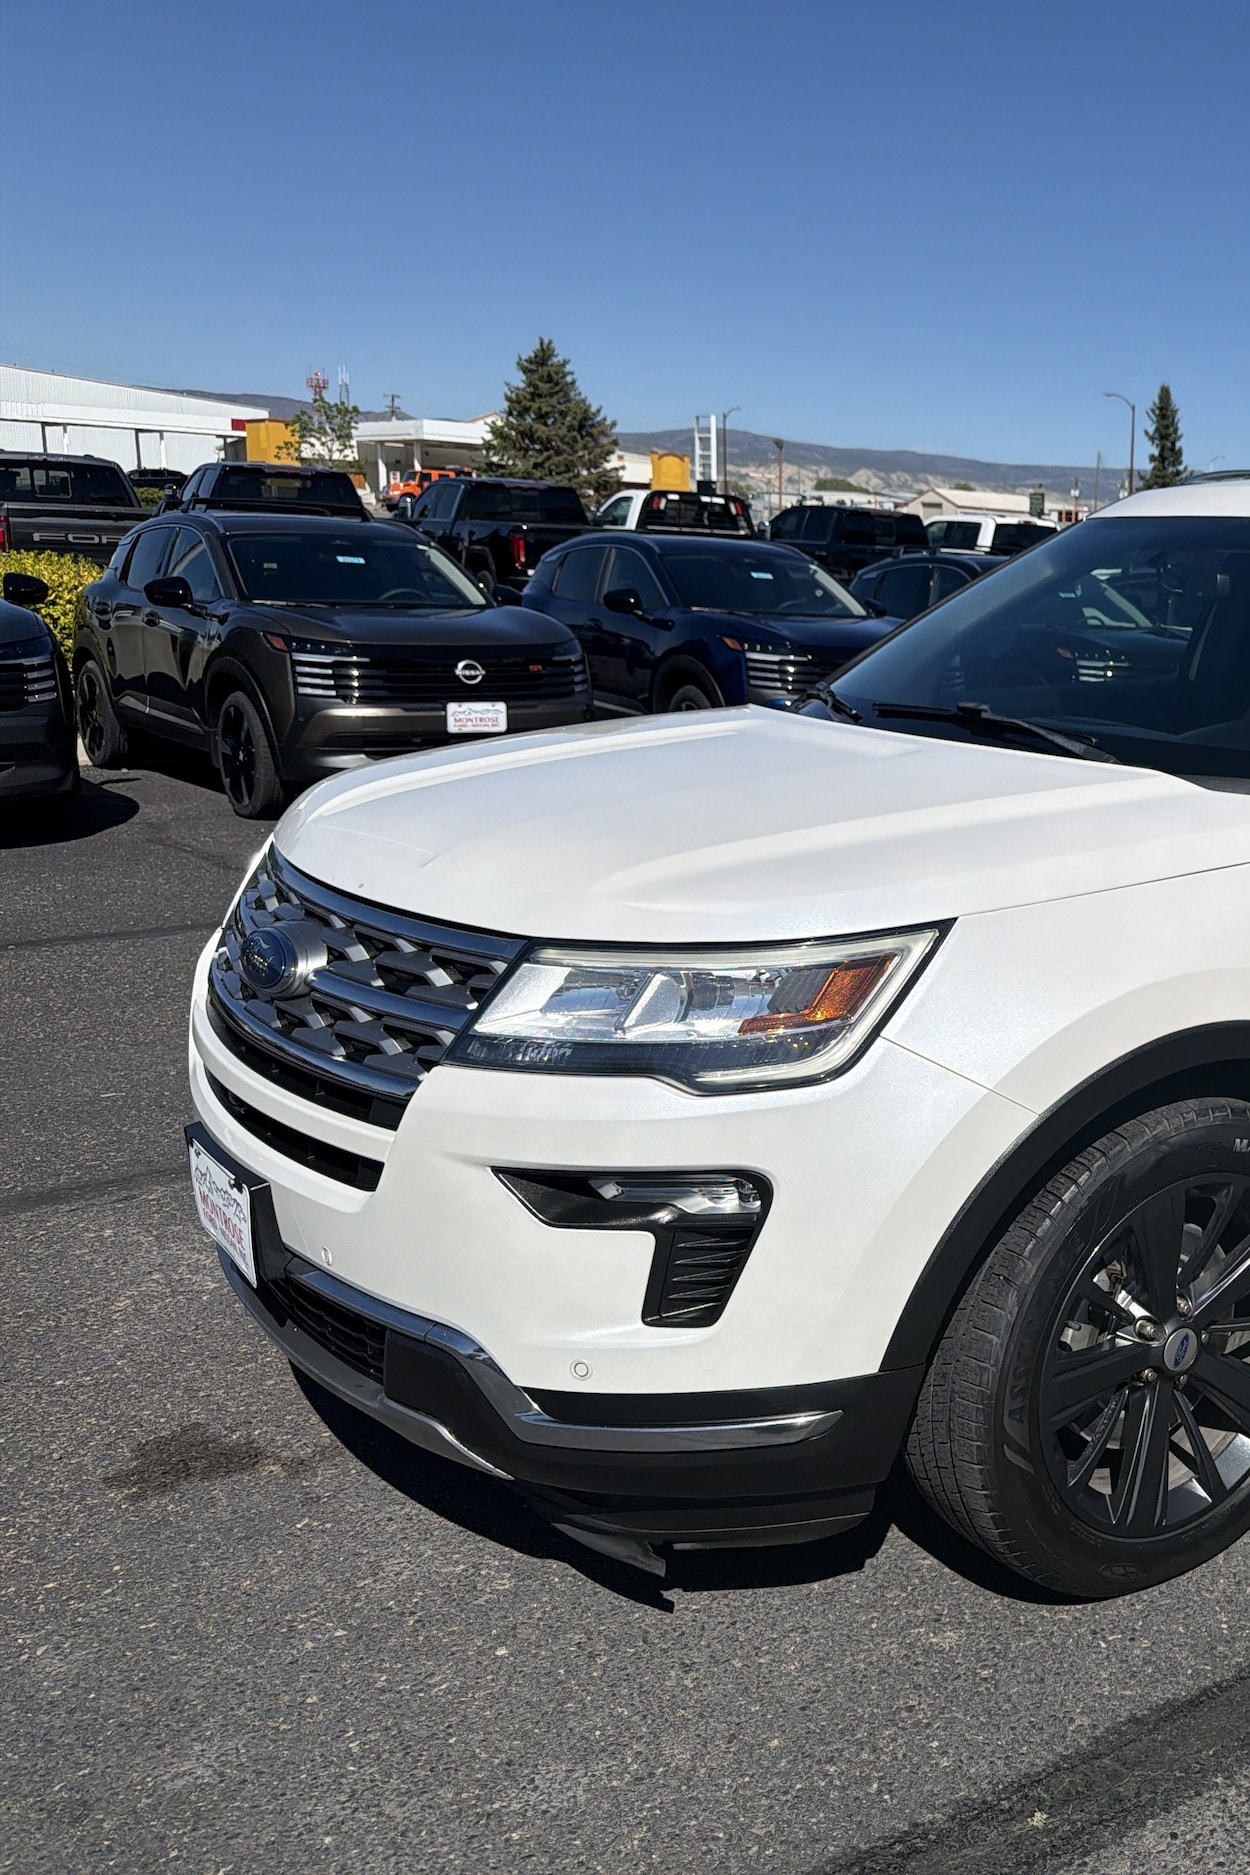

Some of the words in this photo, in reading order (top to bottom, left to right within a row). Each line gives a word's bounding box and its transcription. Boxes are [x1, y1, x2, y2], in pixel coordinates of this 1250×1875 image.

[32, 531, 123, 544] FOR
[453, 716, 499, 724] MONTROSE
[198, 1185, 247, 1252] MONTROSE
